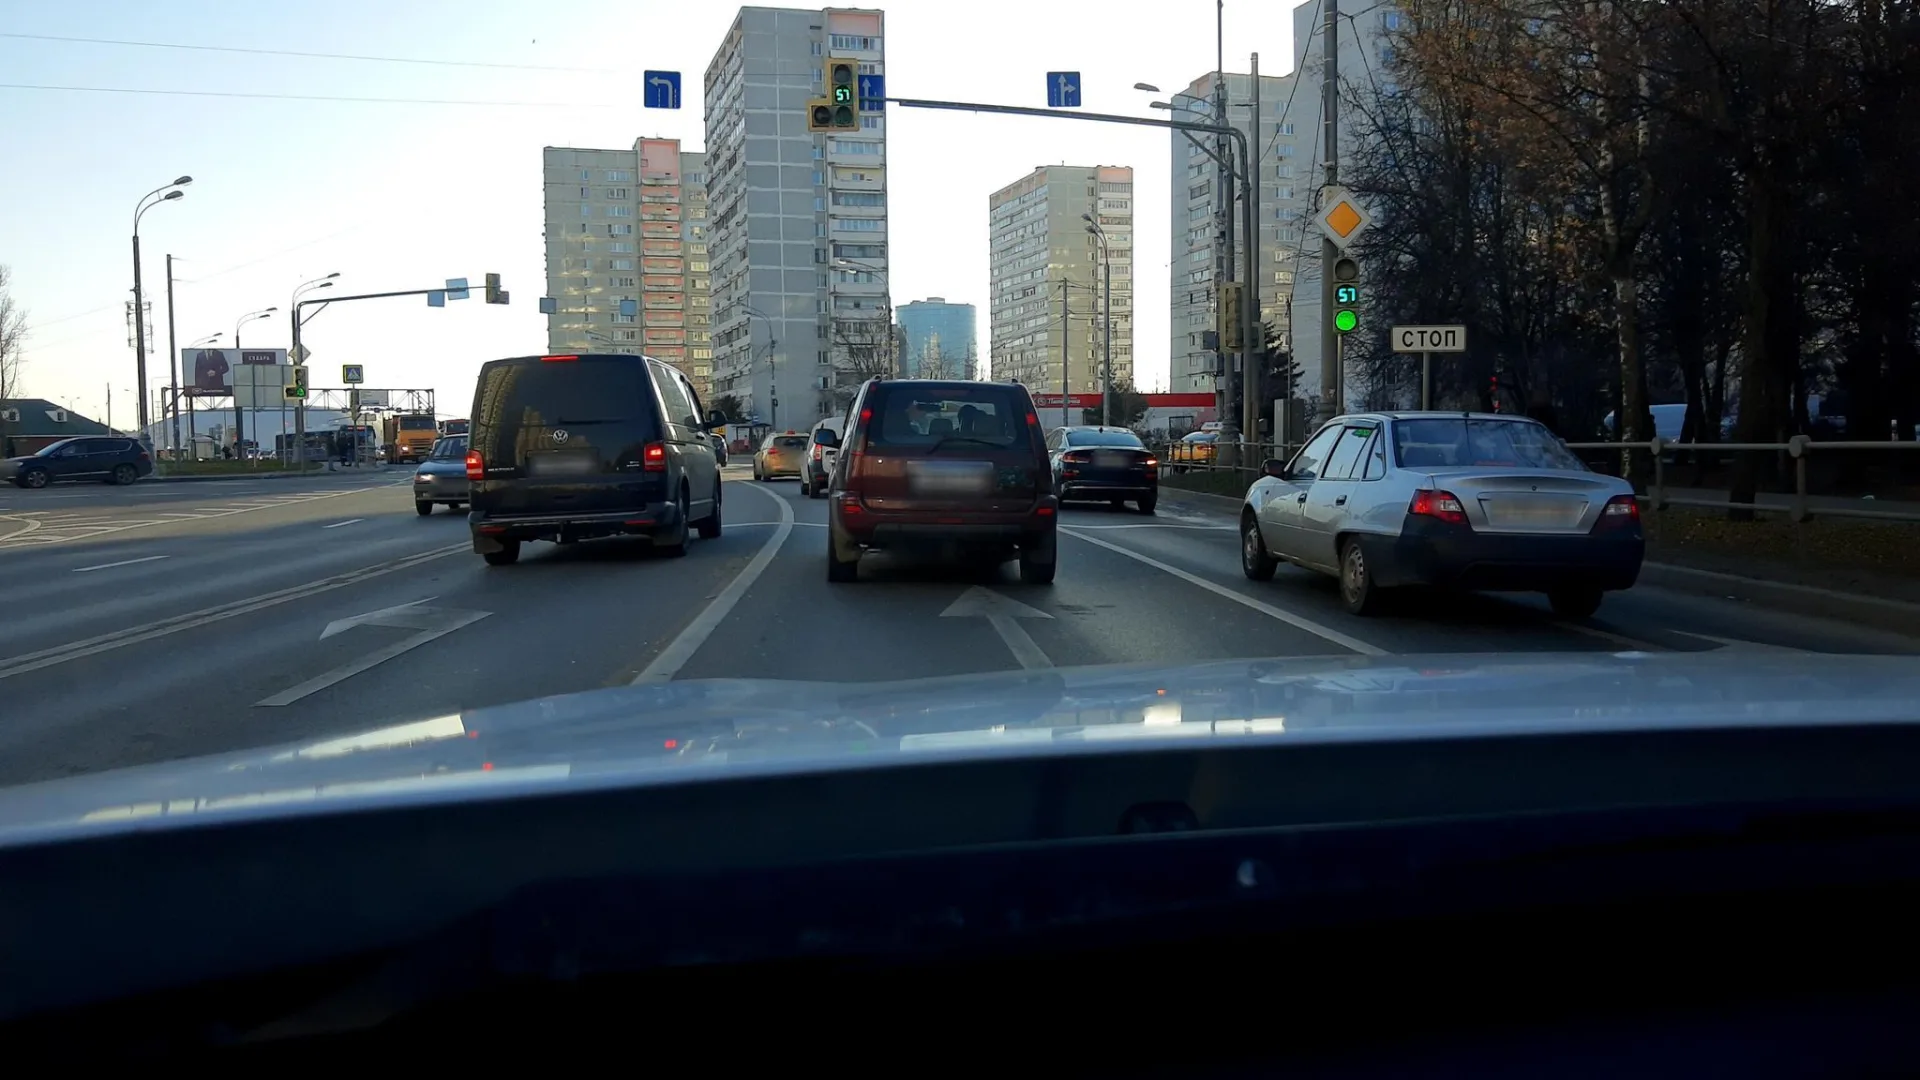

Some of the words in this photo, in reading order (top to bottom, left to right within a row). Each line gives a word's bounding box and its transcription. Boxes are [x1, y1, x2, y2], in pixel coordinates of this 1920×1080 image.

[836, 89, 850, 101] 57
[1338, 288, 1356, 302] 57
[1402, 330, 1456, 347] СТОП
